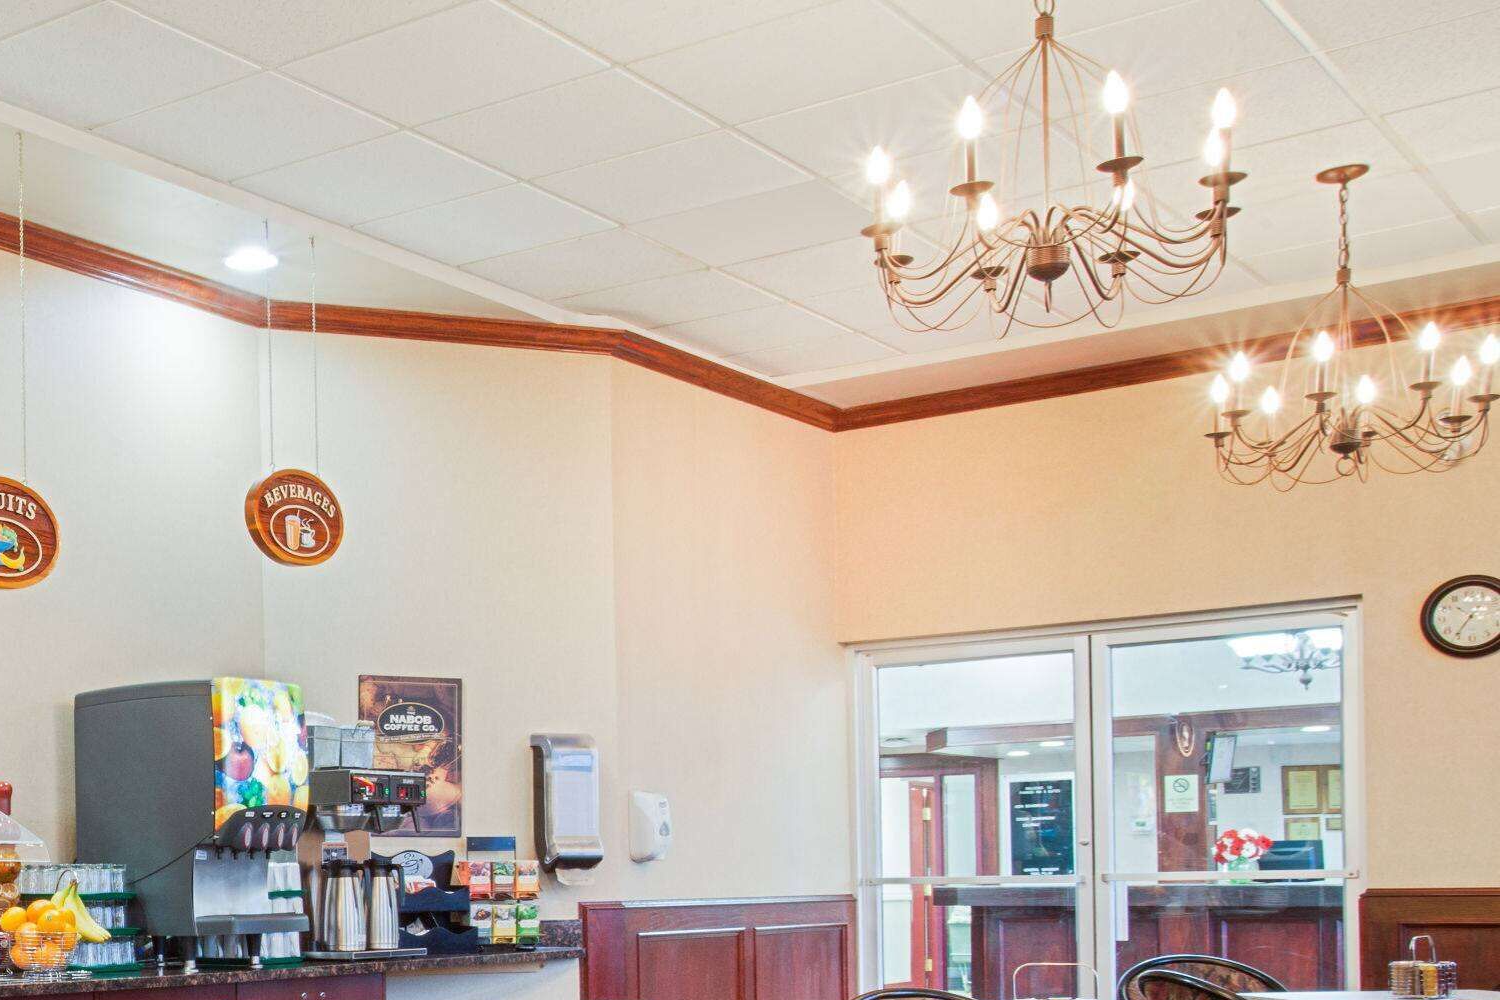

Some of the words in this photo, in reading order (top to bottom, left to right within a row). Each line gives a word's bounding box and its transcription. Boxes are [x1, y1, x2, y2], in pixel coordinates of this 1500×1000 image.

[263, 484, 336, 518] BEVERAGES
[383, 723, 420, 732] COFFEE
[422, 724, 438, 732] CO.
